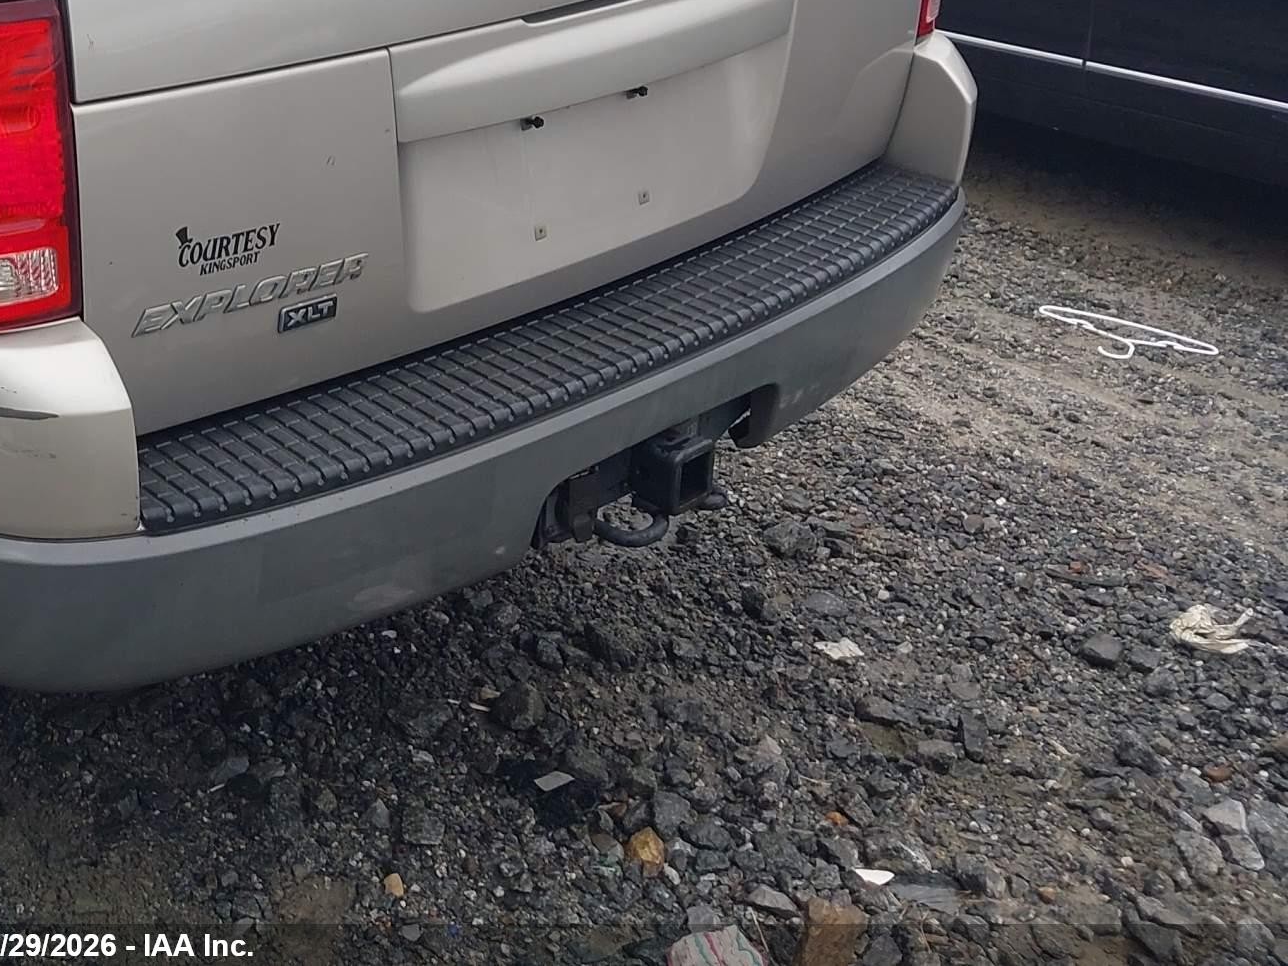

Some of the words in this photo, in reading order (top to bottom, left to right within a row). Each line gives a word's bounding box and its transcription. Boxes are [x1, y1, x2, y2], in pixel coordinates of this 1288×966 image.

[178, 223, 281, 268] COURTESY
[200, 251, 261, 276] KINGSPORT
[131, 251, 369, 338] EXPLORER
[287, 300, 334, 328] XLT
